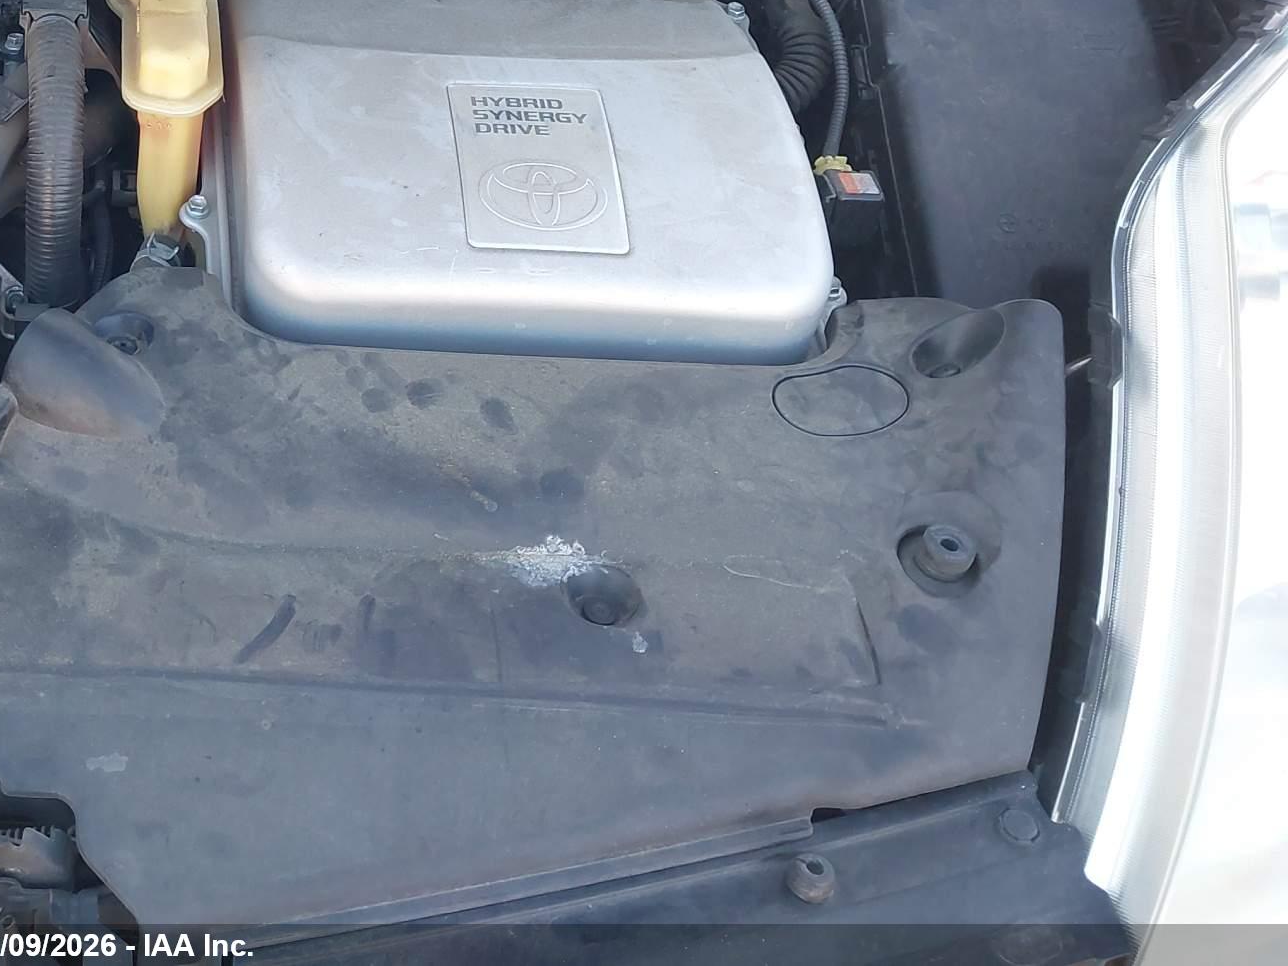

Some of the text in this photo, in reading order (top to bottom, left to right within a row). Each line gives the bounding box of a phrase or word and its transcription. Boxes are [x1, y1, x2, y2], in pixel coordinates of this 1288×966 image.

[470, 96, 563, 109] HYBRID
[472, 110, 587, 124] SYNERGY
[475, 123, 550, 136] DRIVE
